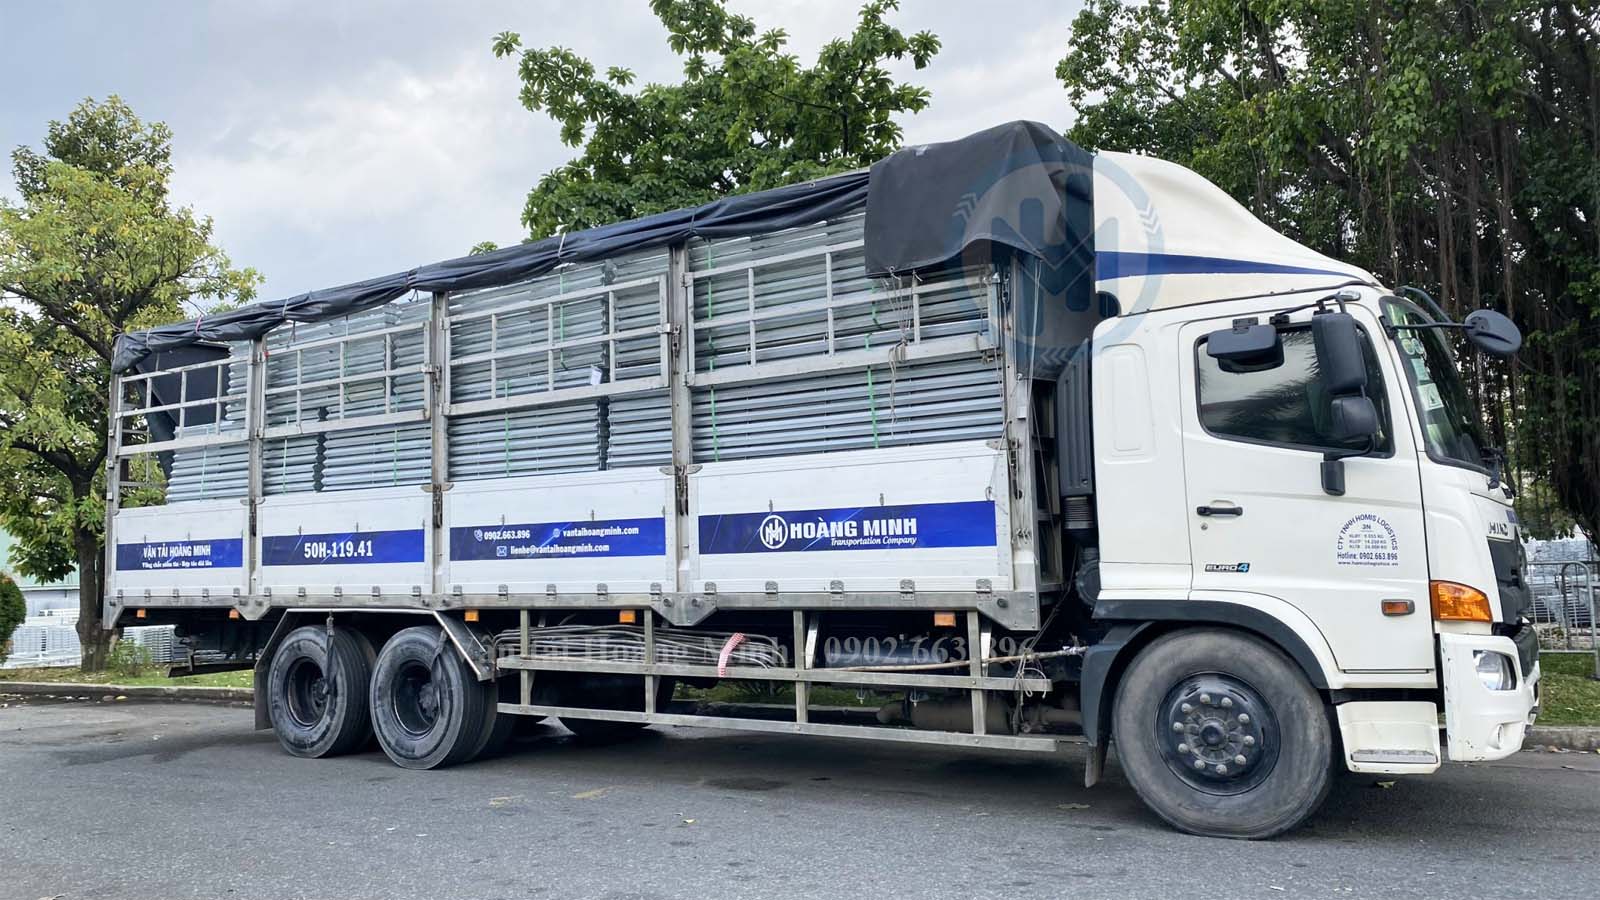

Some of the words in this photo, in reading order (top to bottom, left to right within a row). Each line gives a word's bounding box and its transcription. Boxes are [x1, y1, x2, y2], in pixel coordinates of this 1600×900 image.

[562, 526, 639, 538] vantaihoangminh.com
[791, 516, 858, 539] HOÀNG
[863, 518, 917, 536] MINH
[1355, 514, 1377, 522] HOMIS
[1377, 517, 1398, 551] LOGISTICS
[483, 529, 530, 540] 0902.663.896
[831, 537, 882, 547] Transportation
[882, 536, 917, 546] Company
[143, 545, 157, 560] VẬN
[157, 543, 168, 557] TẢI
[169, 543, 192, 557] HOÀNG
[193, 544, 211, 556] MINH
[304, 540, 373, 558] 50H-119.41
[510, 543, 610, 555] lienhe@vantaihoangminh.com
[1359, 552, 1398, 560] 0902.663.896
